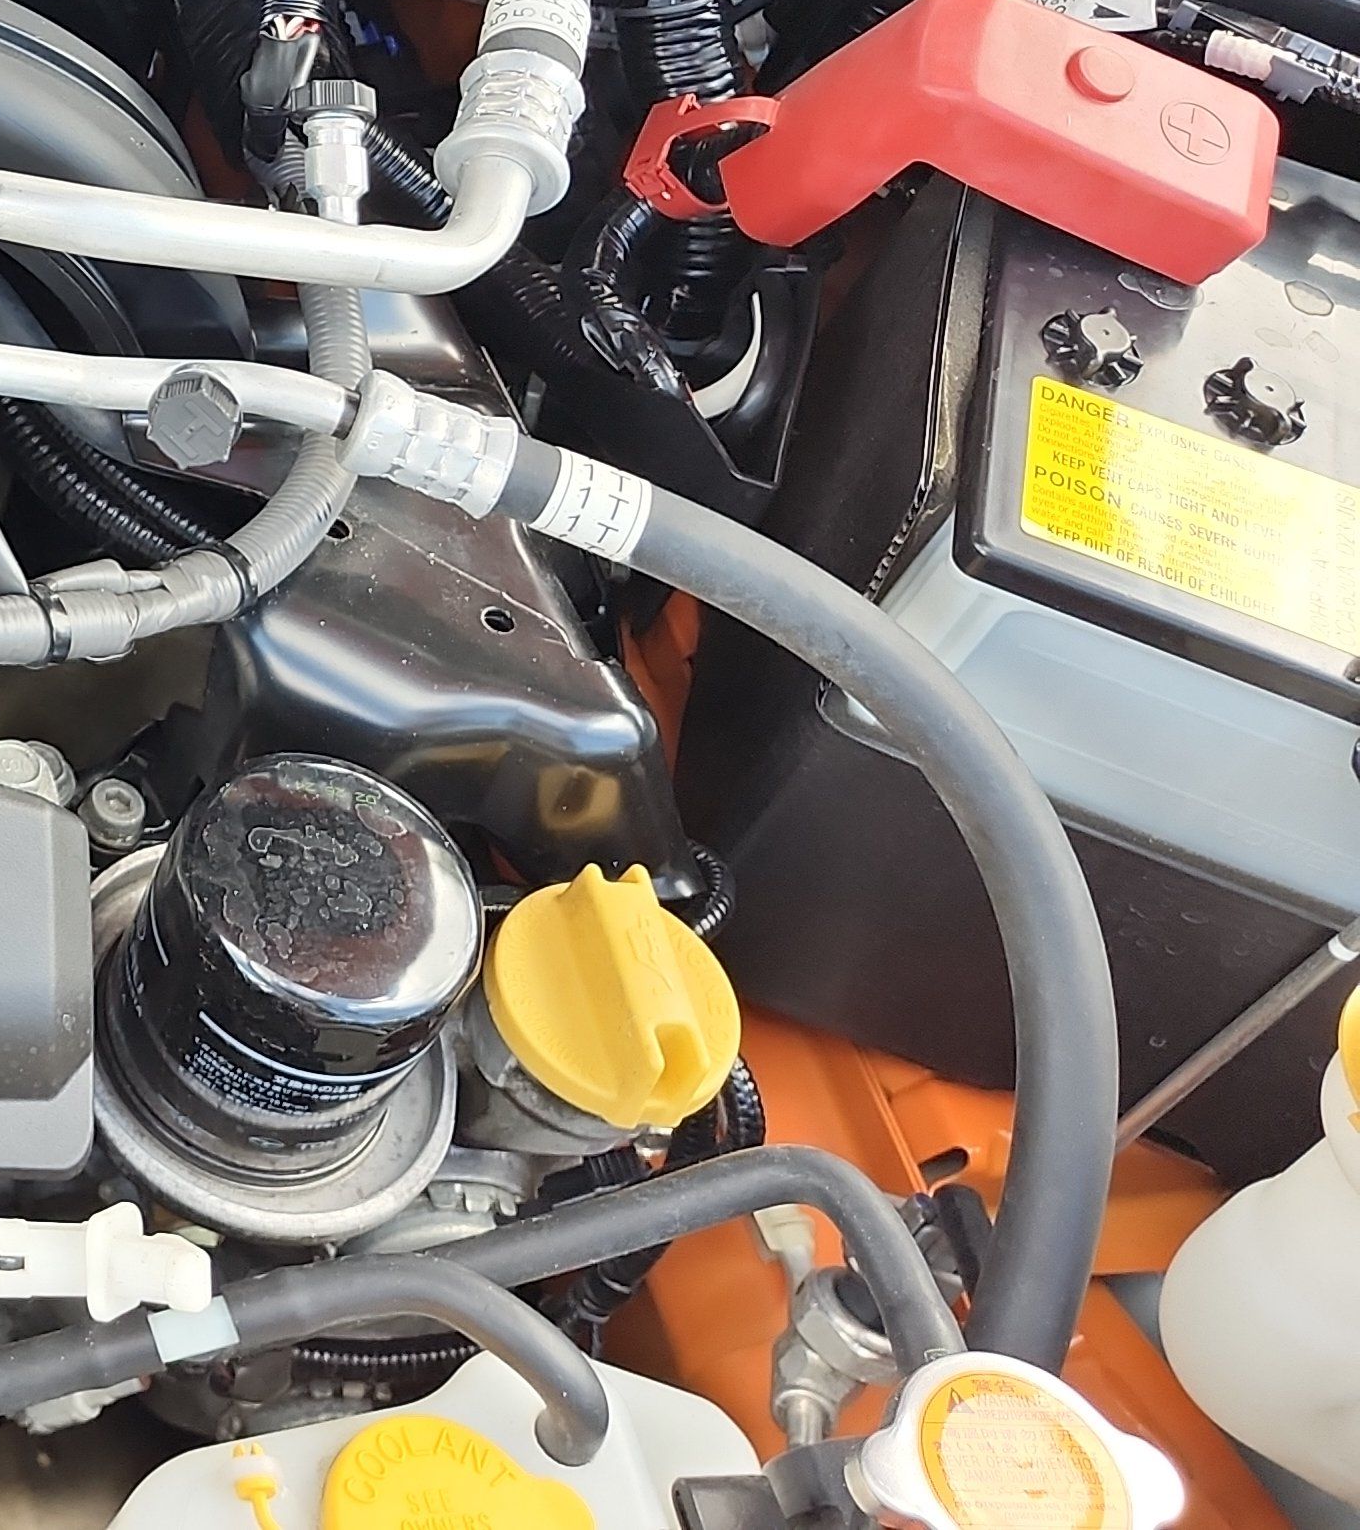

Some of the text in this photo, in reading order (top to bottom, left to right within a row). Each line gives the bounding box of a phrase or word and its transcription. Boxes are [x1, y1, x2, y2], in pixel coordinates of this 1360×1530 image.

[1041, 386, 1129, 429] DANGER
[1138, 422, 1208, 456] EXPLOSIVE
[1034, 465, 1122, 509] POISON
[1131, 502, 1183, 531] CAUSES
[1188, 523, 1238, 552] SEVERE
[1052, 450, 1086, 470] KEEP
[1090, 463, 1122, 485] VENT
[1128, 478, 1162, 500] CAPS
[1168, 492, 1208, 514] TIGHT
[1211, 508, 1239, 528] AND
[1116, 548, 1135, 562] OF
[1188, 574, 1205, 593] OF
[343, 1425, 516, 1505] COOLANT
[405, 1488, 450, 1514] SEE
